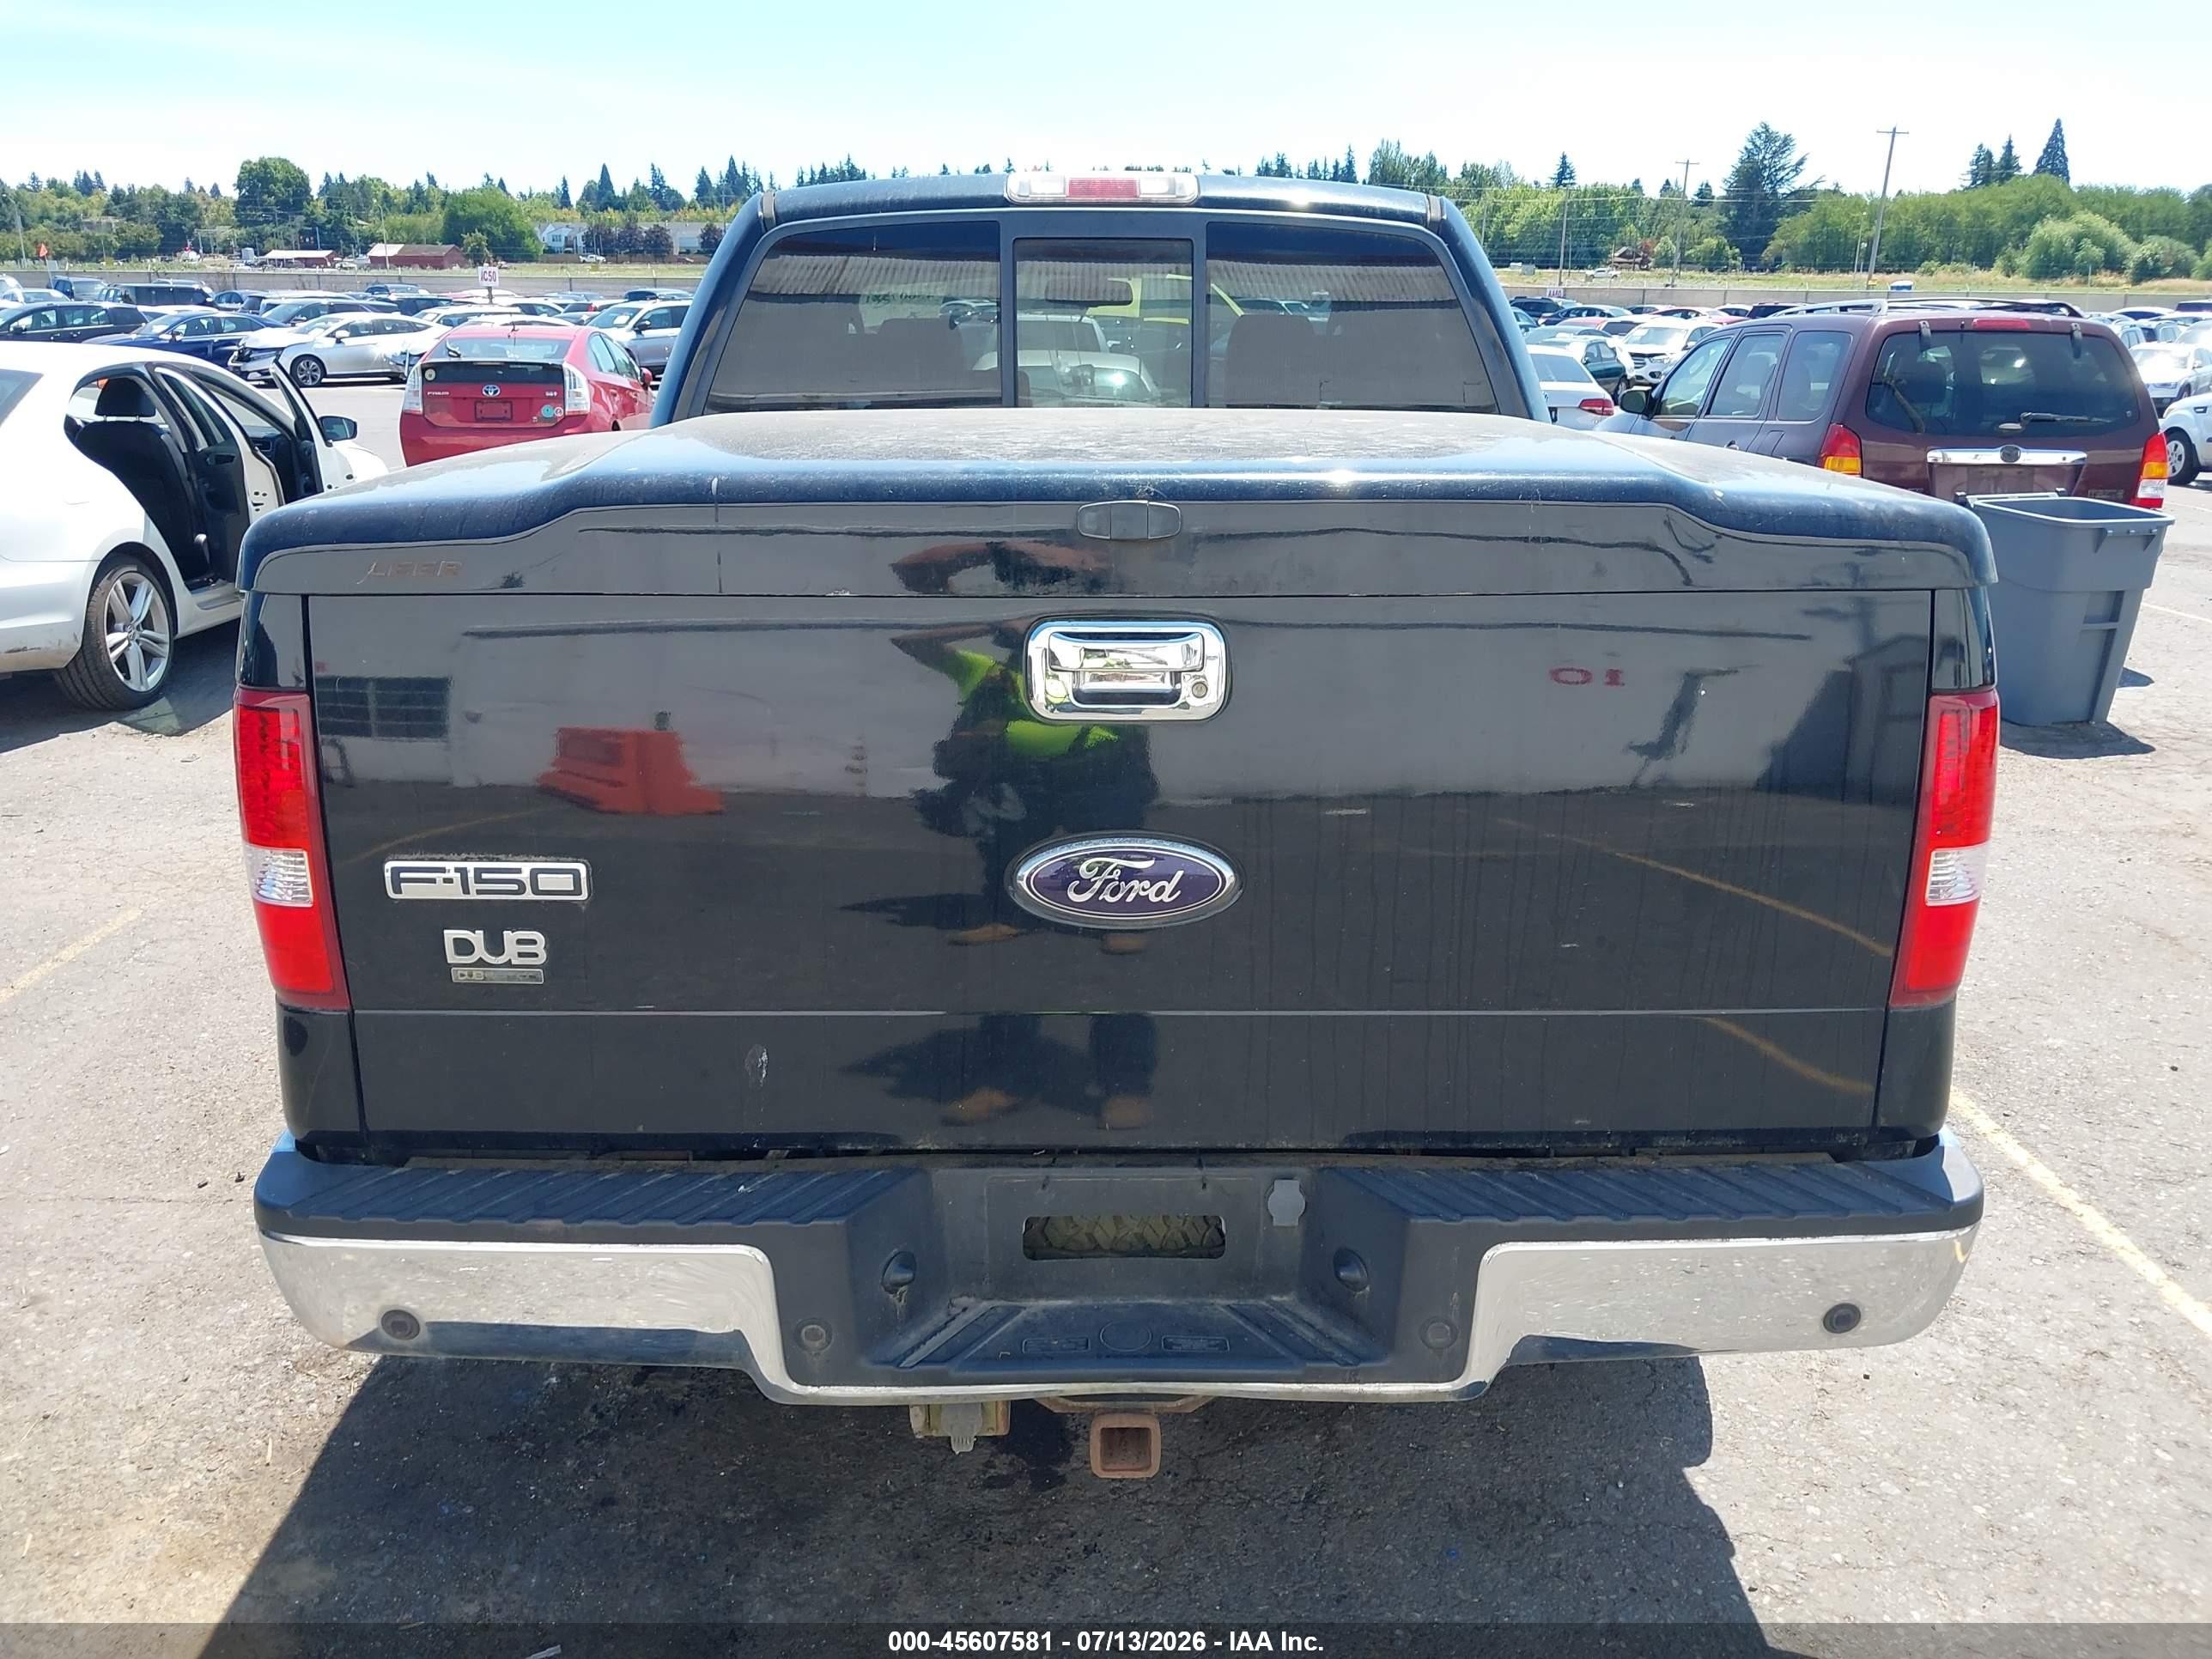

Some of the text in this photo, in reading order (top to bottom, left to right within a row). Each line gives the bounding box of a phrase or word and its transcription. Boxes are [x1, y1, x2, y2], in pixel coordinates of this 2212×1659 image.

[390, 866, 581, 896] F-150
[1067, 857, 1184, 903] Ford
[443, 929, 547, 965] DUB
